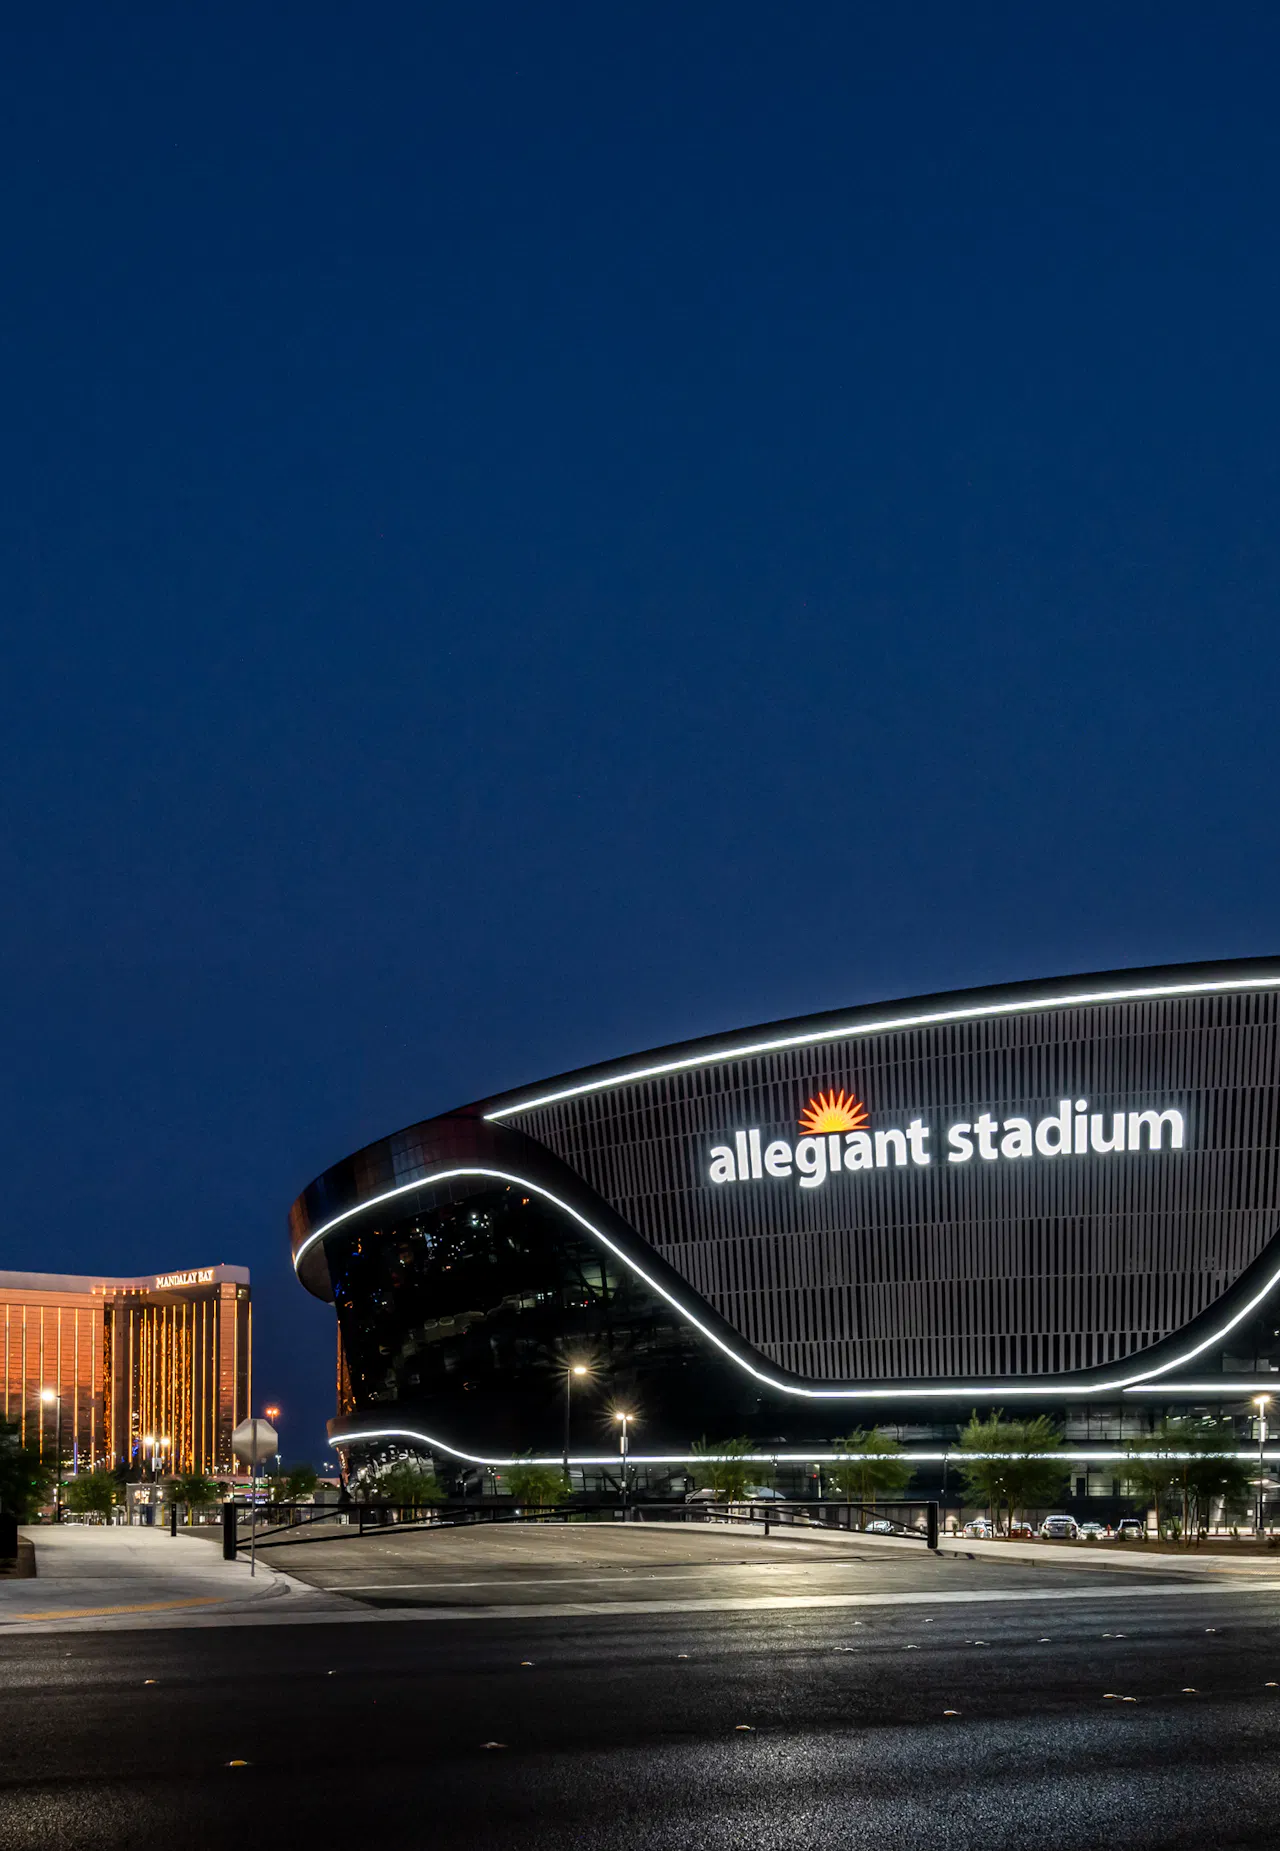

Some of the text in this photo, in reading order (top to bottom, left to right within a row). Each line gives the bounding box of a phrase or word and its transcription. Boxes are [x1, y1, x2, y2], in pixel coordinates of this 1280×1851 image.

[708, 1099, 1185, 1188] allegiant stadium
[155, 1269, 214, 1289] MANDALAY BAY
